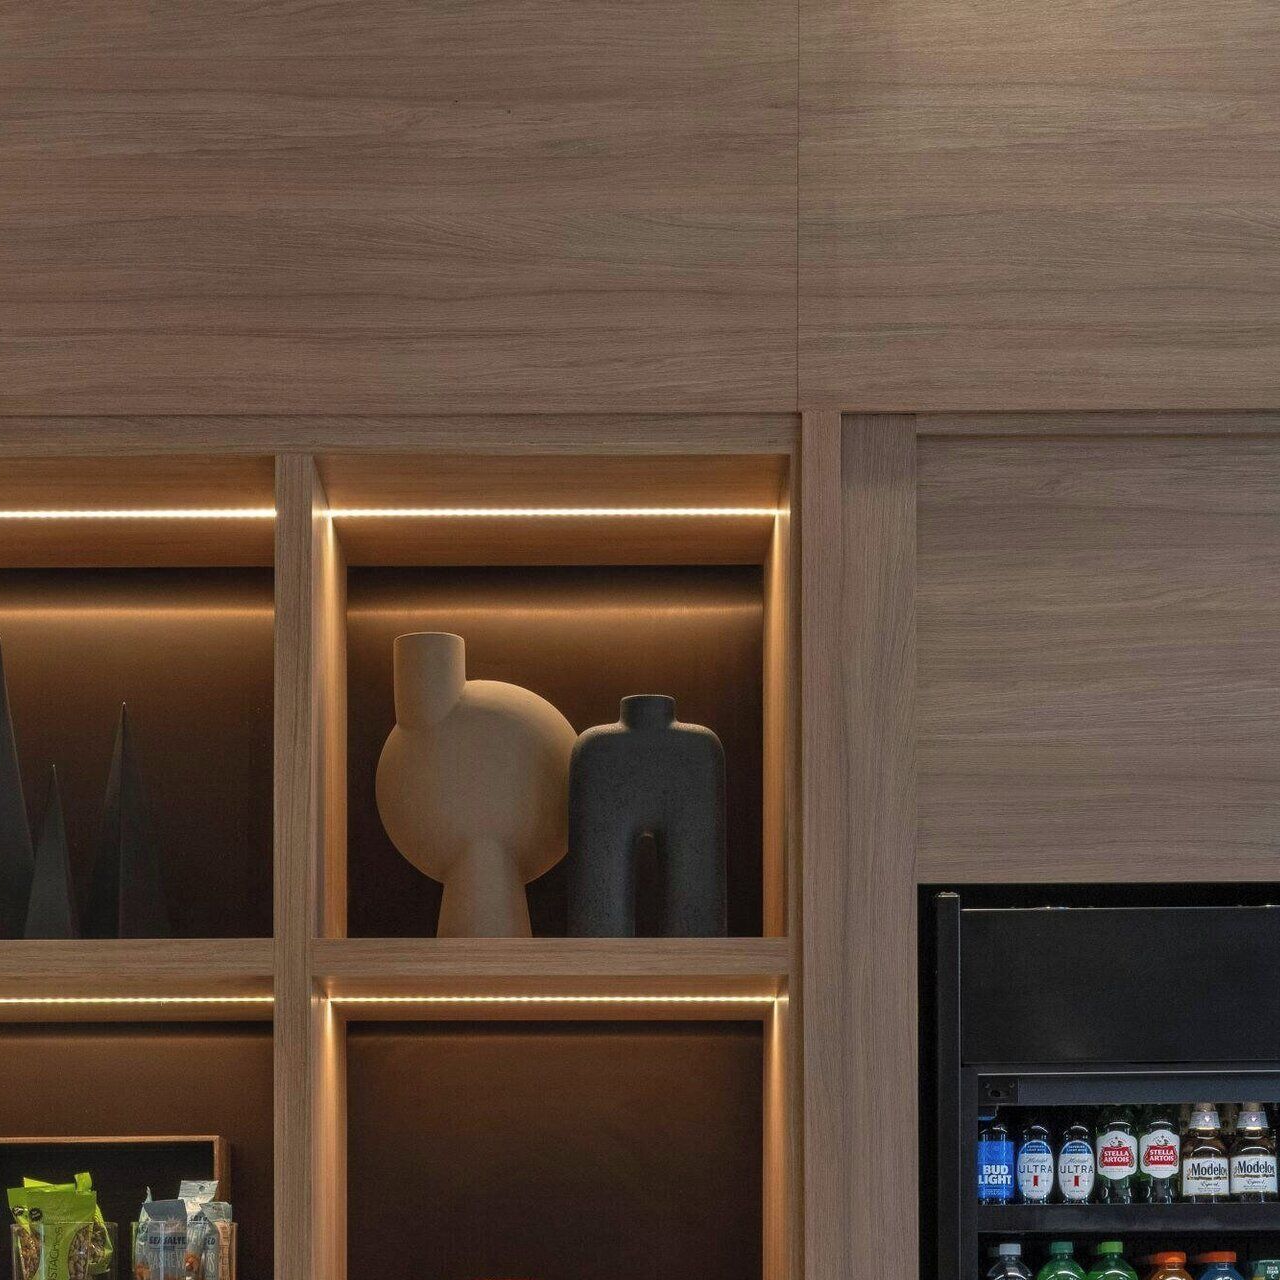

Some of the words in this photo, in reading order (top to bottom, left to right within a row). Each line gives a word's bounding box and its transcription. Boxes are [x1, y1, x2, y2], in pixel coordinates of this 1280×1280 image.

[983, 1165, 1009, 1175] BUD
[1019, 1164, 1053, 1174] ULTRA
[1060, 1164, 1094, 1174] ULTRA
[978, 1175, 1012, 1185] LIGHT
